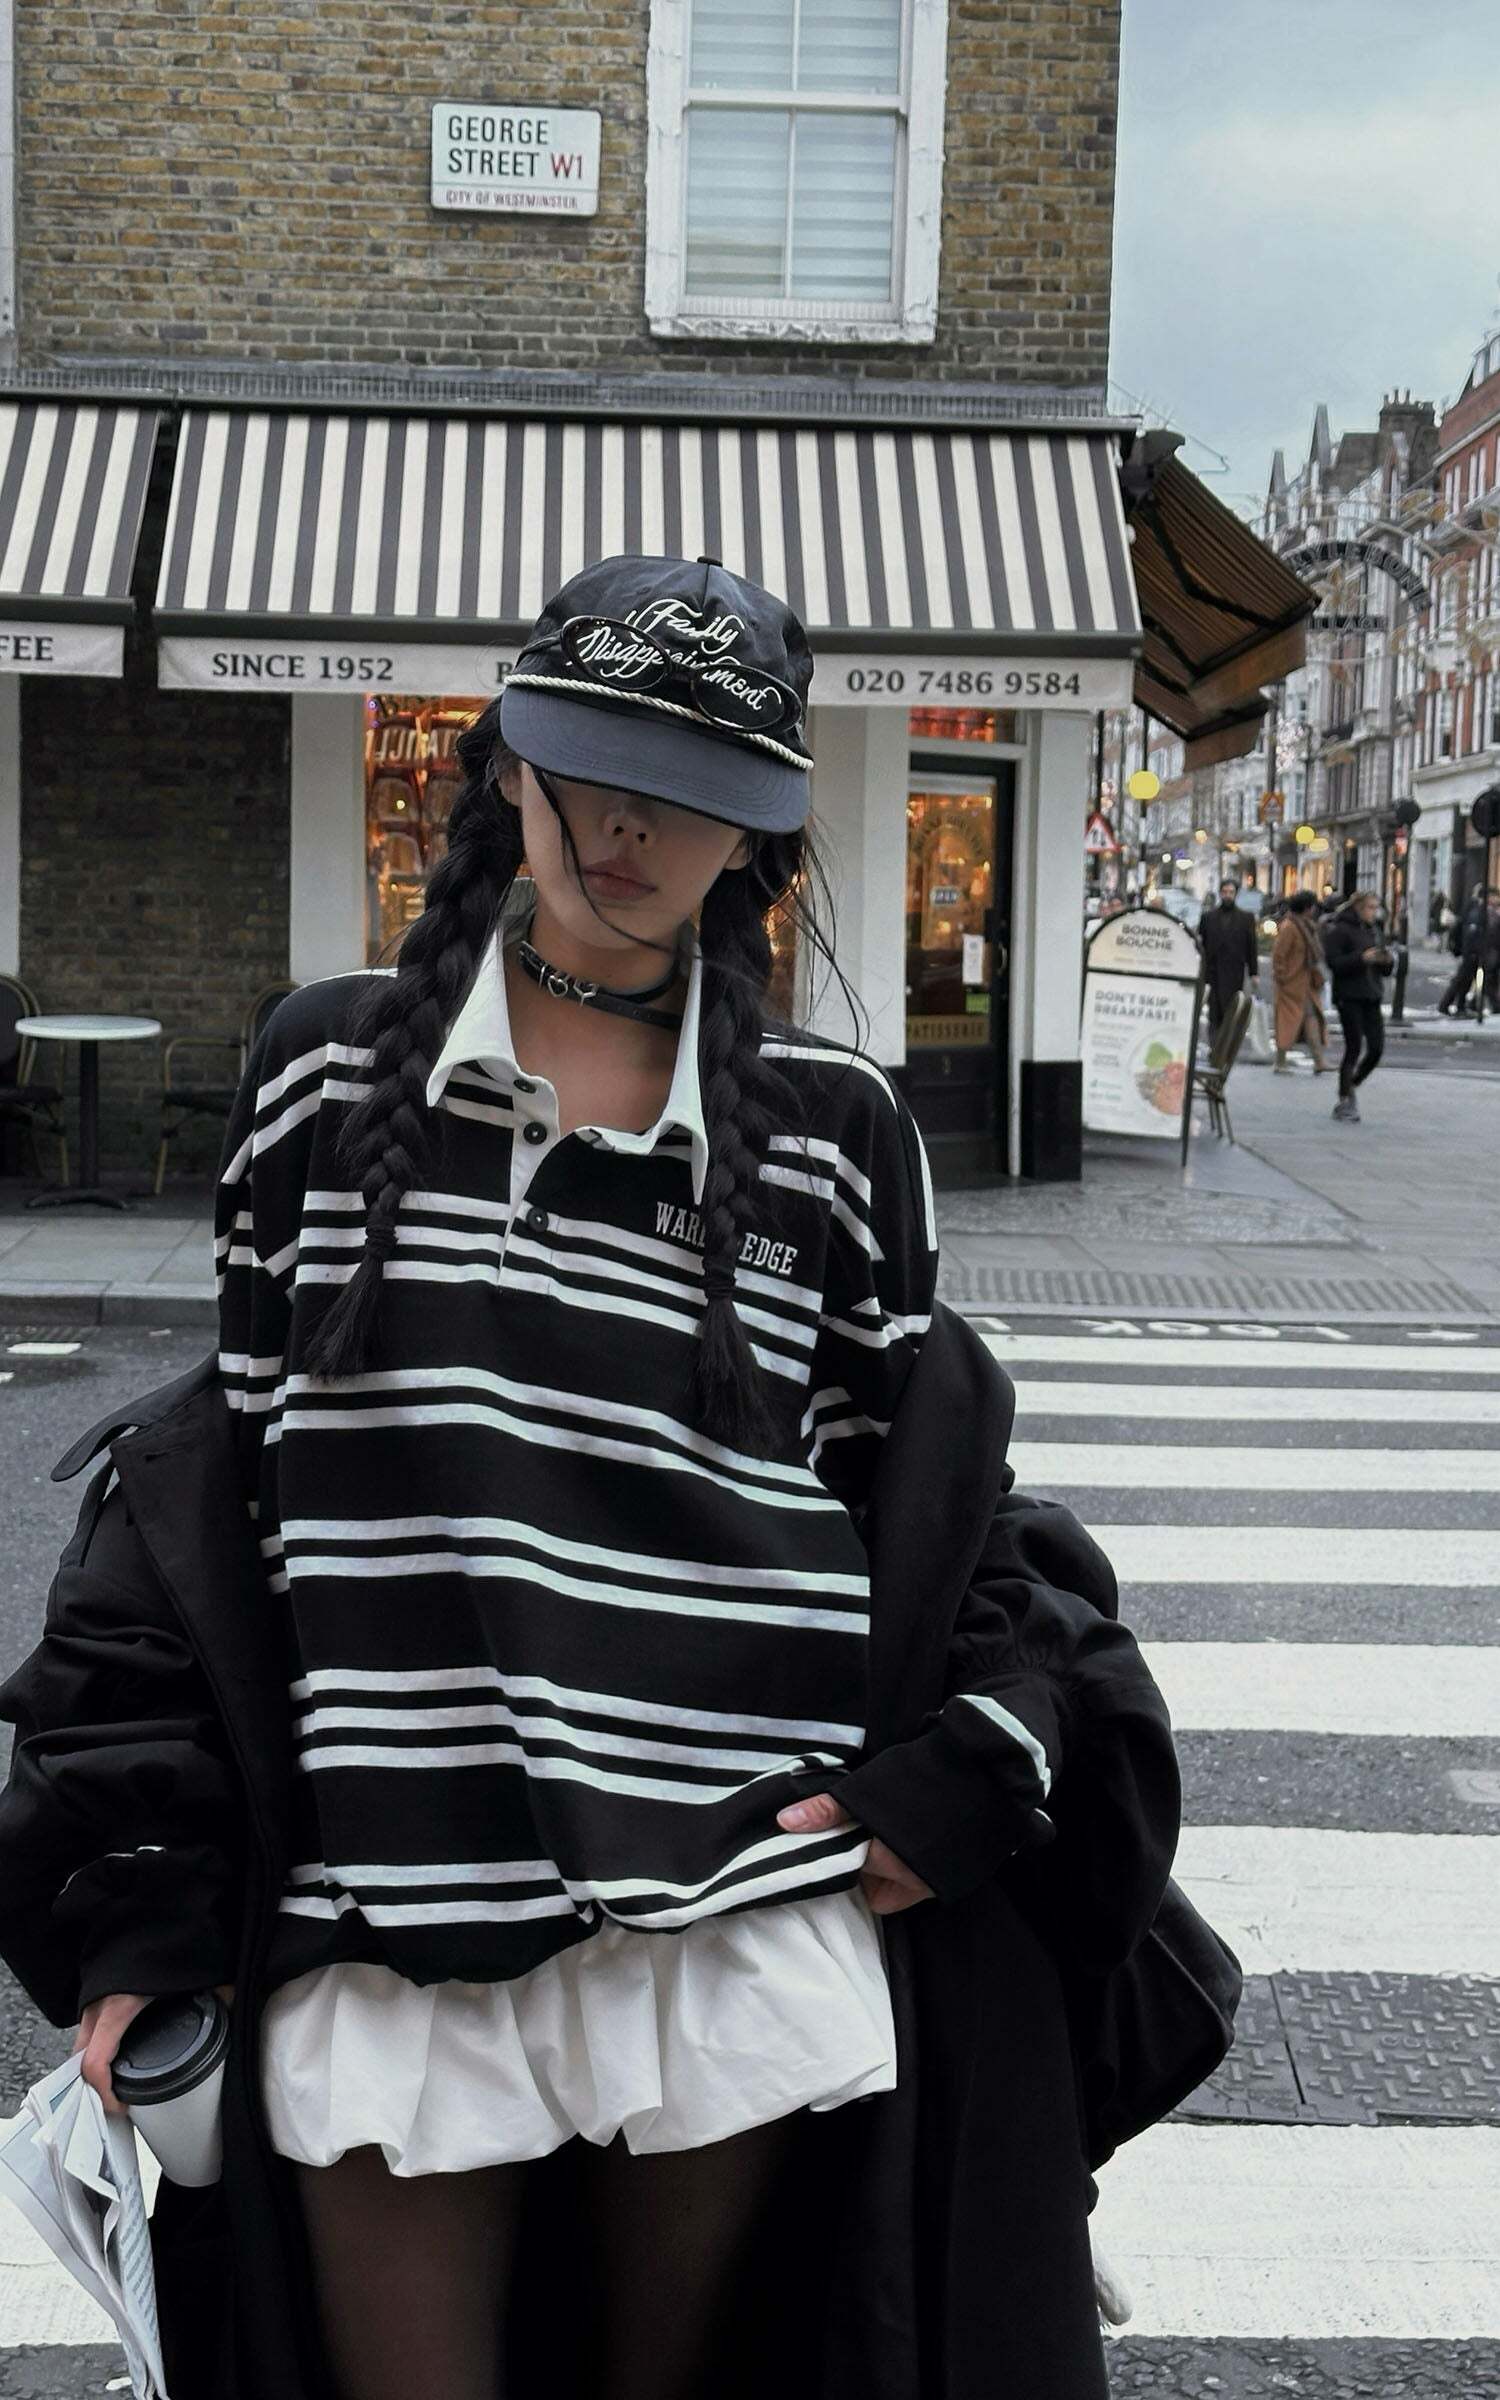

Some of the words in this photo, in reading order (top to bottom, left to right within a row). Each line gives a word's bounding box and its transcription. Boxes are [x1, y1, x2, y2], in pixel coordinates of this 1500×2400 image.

[448, 115, 549, 145] GEORGE
[448, 148, 540, 177] STREET
[551, 152, 583, 179] W1
[446, 190, 472, 204] CITY
[212, 652, 306, 679] SINCE
[318, 656, 393, 681] 1952
[847, 668, 905, 693] 020
[918, 670, 993, 695] 7486
[1004, 671, 1081, 696] 9584
[1115, 935, 1173, 951] BOUCHE
[1121, 923, 1170, 938] BONNE
